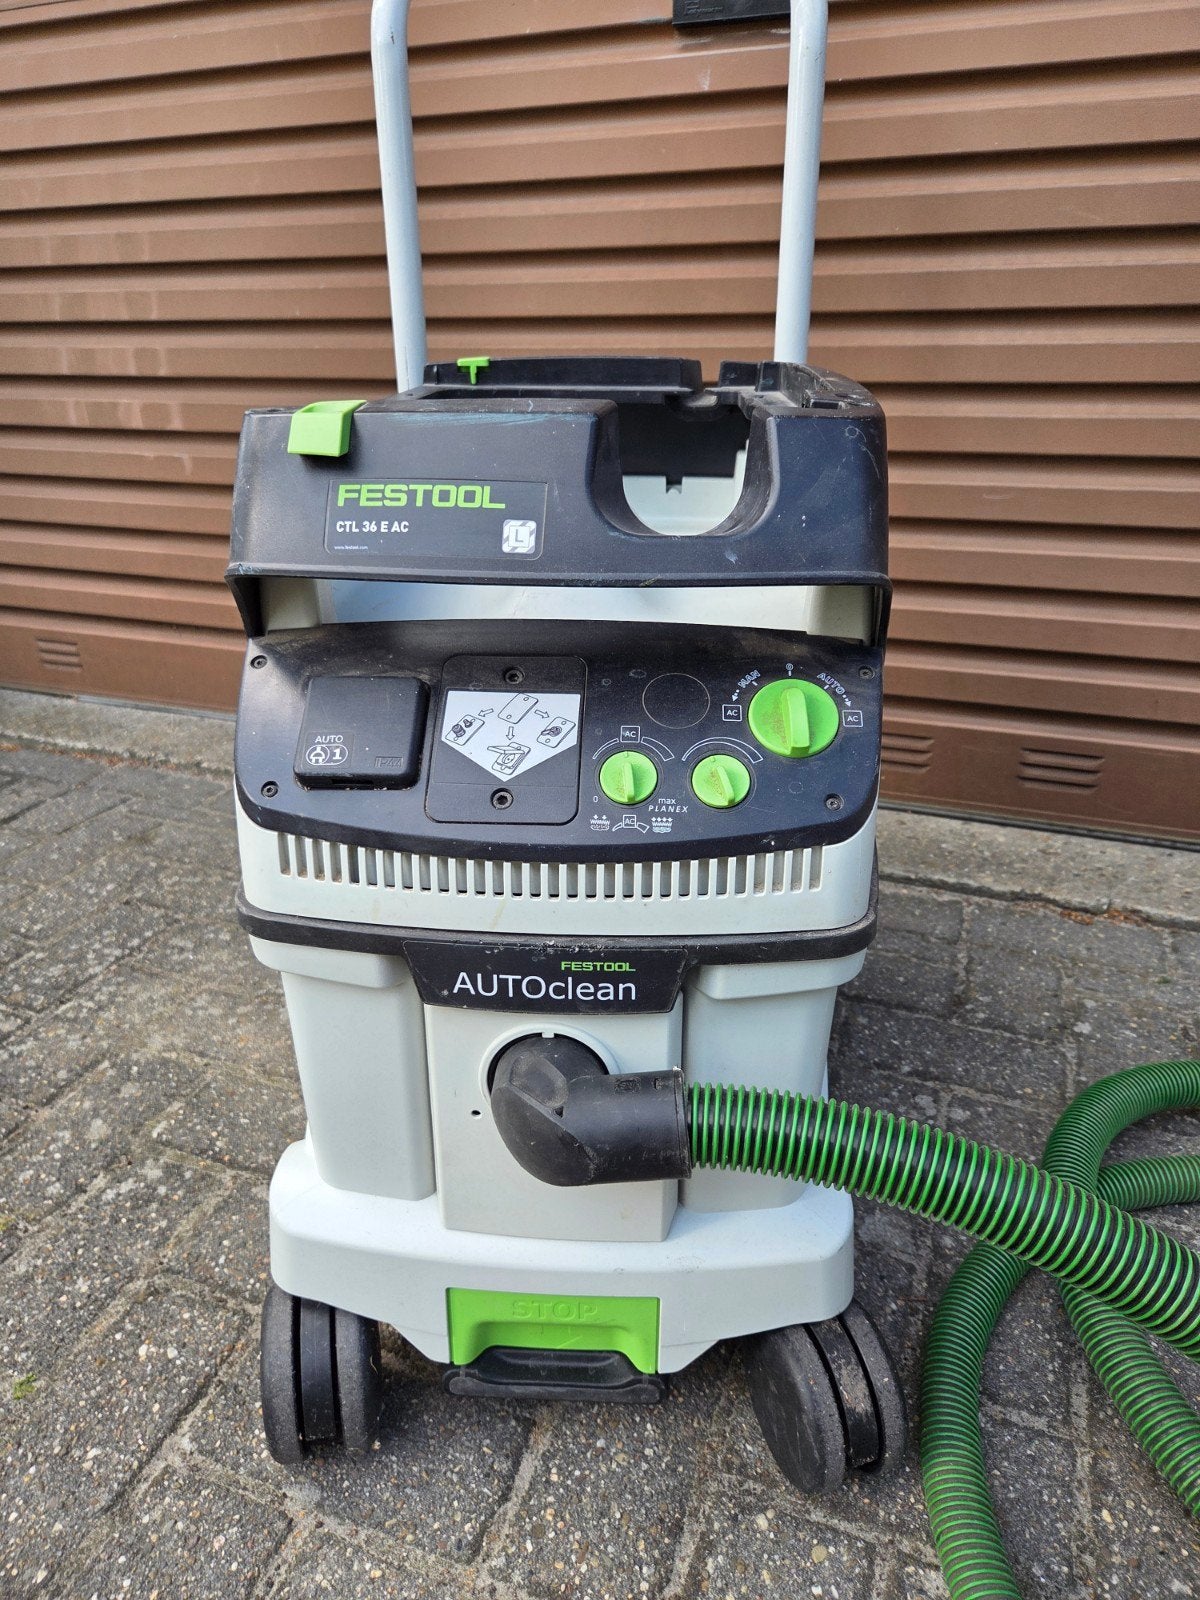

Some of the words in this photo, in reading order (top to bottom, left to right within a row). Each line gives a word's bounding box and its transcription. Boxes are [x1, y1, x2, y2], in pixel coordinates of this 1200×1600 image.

[337, 484, 506, 509] FESTOOL
[336, 520, 360, 533] CTL
[362, 520, 377, 533] 36
[380, 520, 389, 533] E
[391, 521, 410, 533] AC
[514, 528, 524, 543] L
[816, 672, 846, 696] AUTO
[726, 709, 739, 717] AC
[846, 715, 860, 723] AC
[314, 734, 344, 744] AUTO
[624, 730, 637, 738] AC
[332, 748, 342, 760] 1
[648, 804, 689, 814] PLANEX
[625, 817, 635, 825] AC
[560, 961, 637, 972] FESTOOL
[452, 971, 637, 1001] AUTOclean
[512, 1299, 598, 1321] STOP
